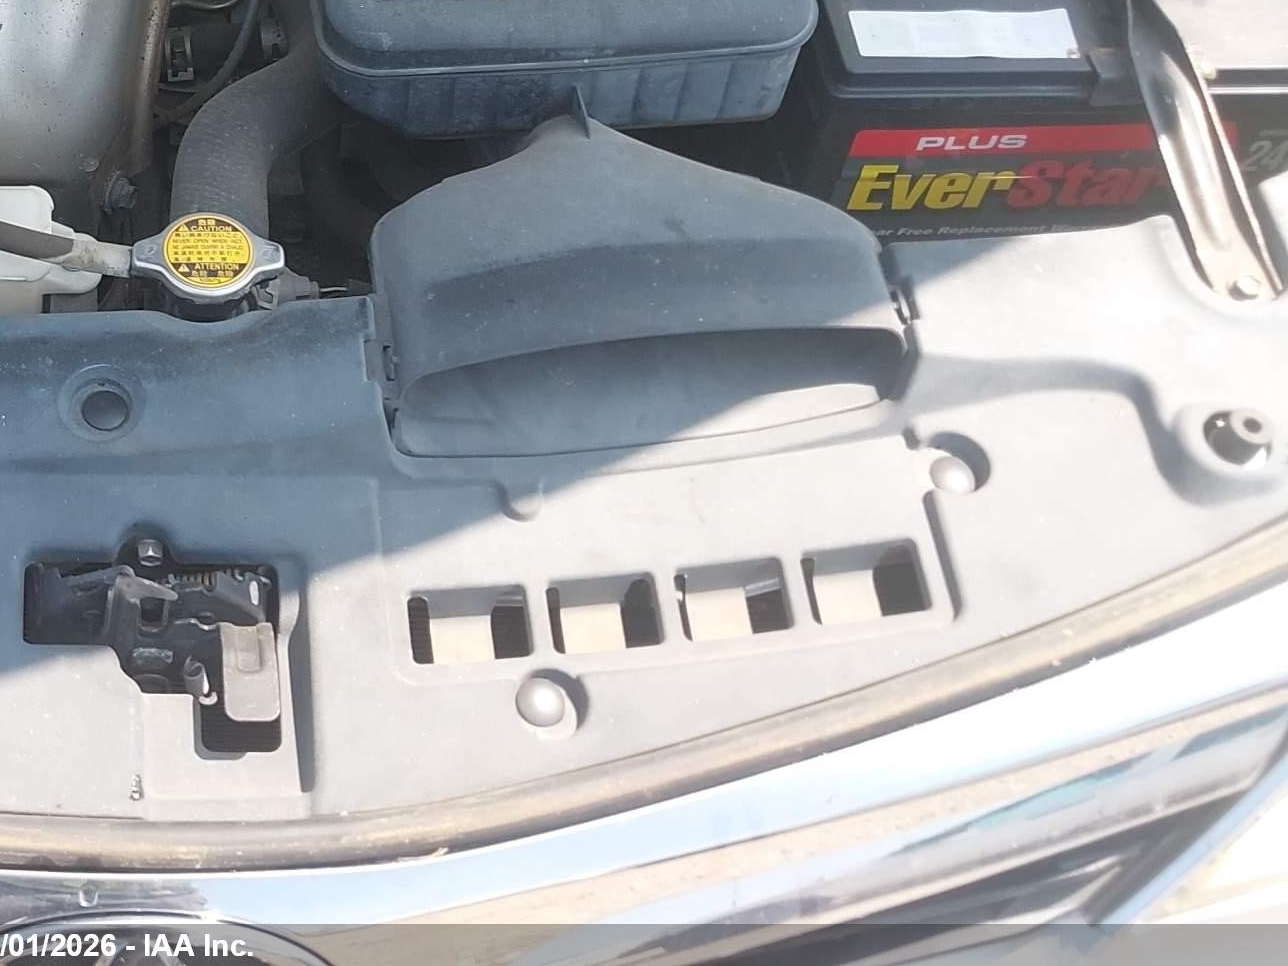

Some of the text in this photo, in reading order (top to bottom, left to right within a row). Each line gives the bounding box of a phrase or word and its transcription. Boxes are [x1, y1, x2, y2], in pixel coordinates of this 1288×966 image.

[915, 134, 1029, 151] PLUS
[846, 159, 1169, 211] EverStar
[896, 225, 935, 236] Free
[937, 222, 1045, 236] Replacement
